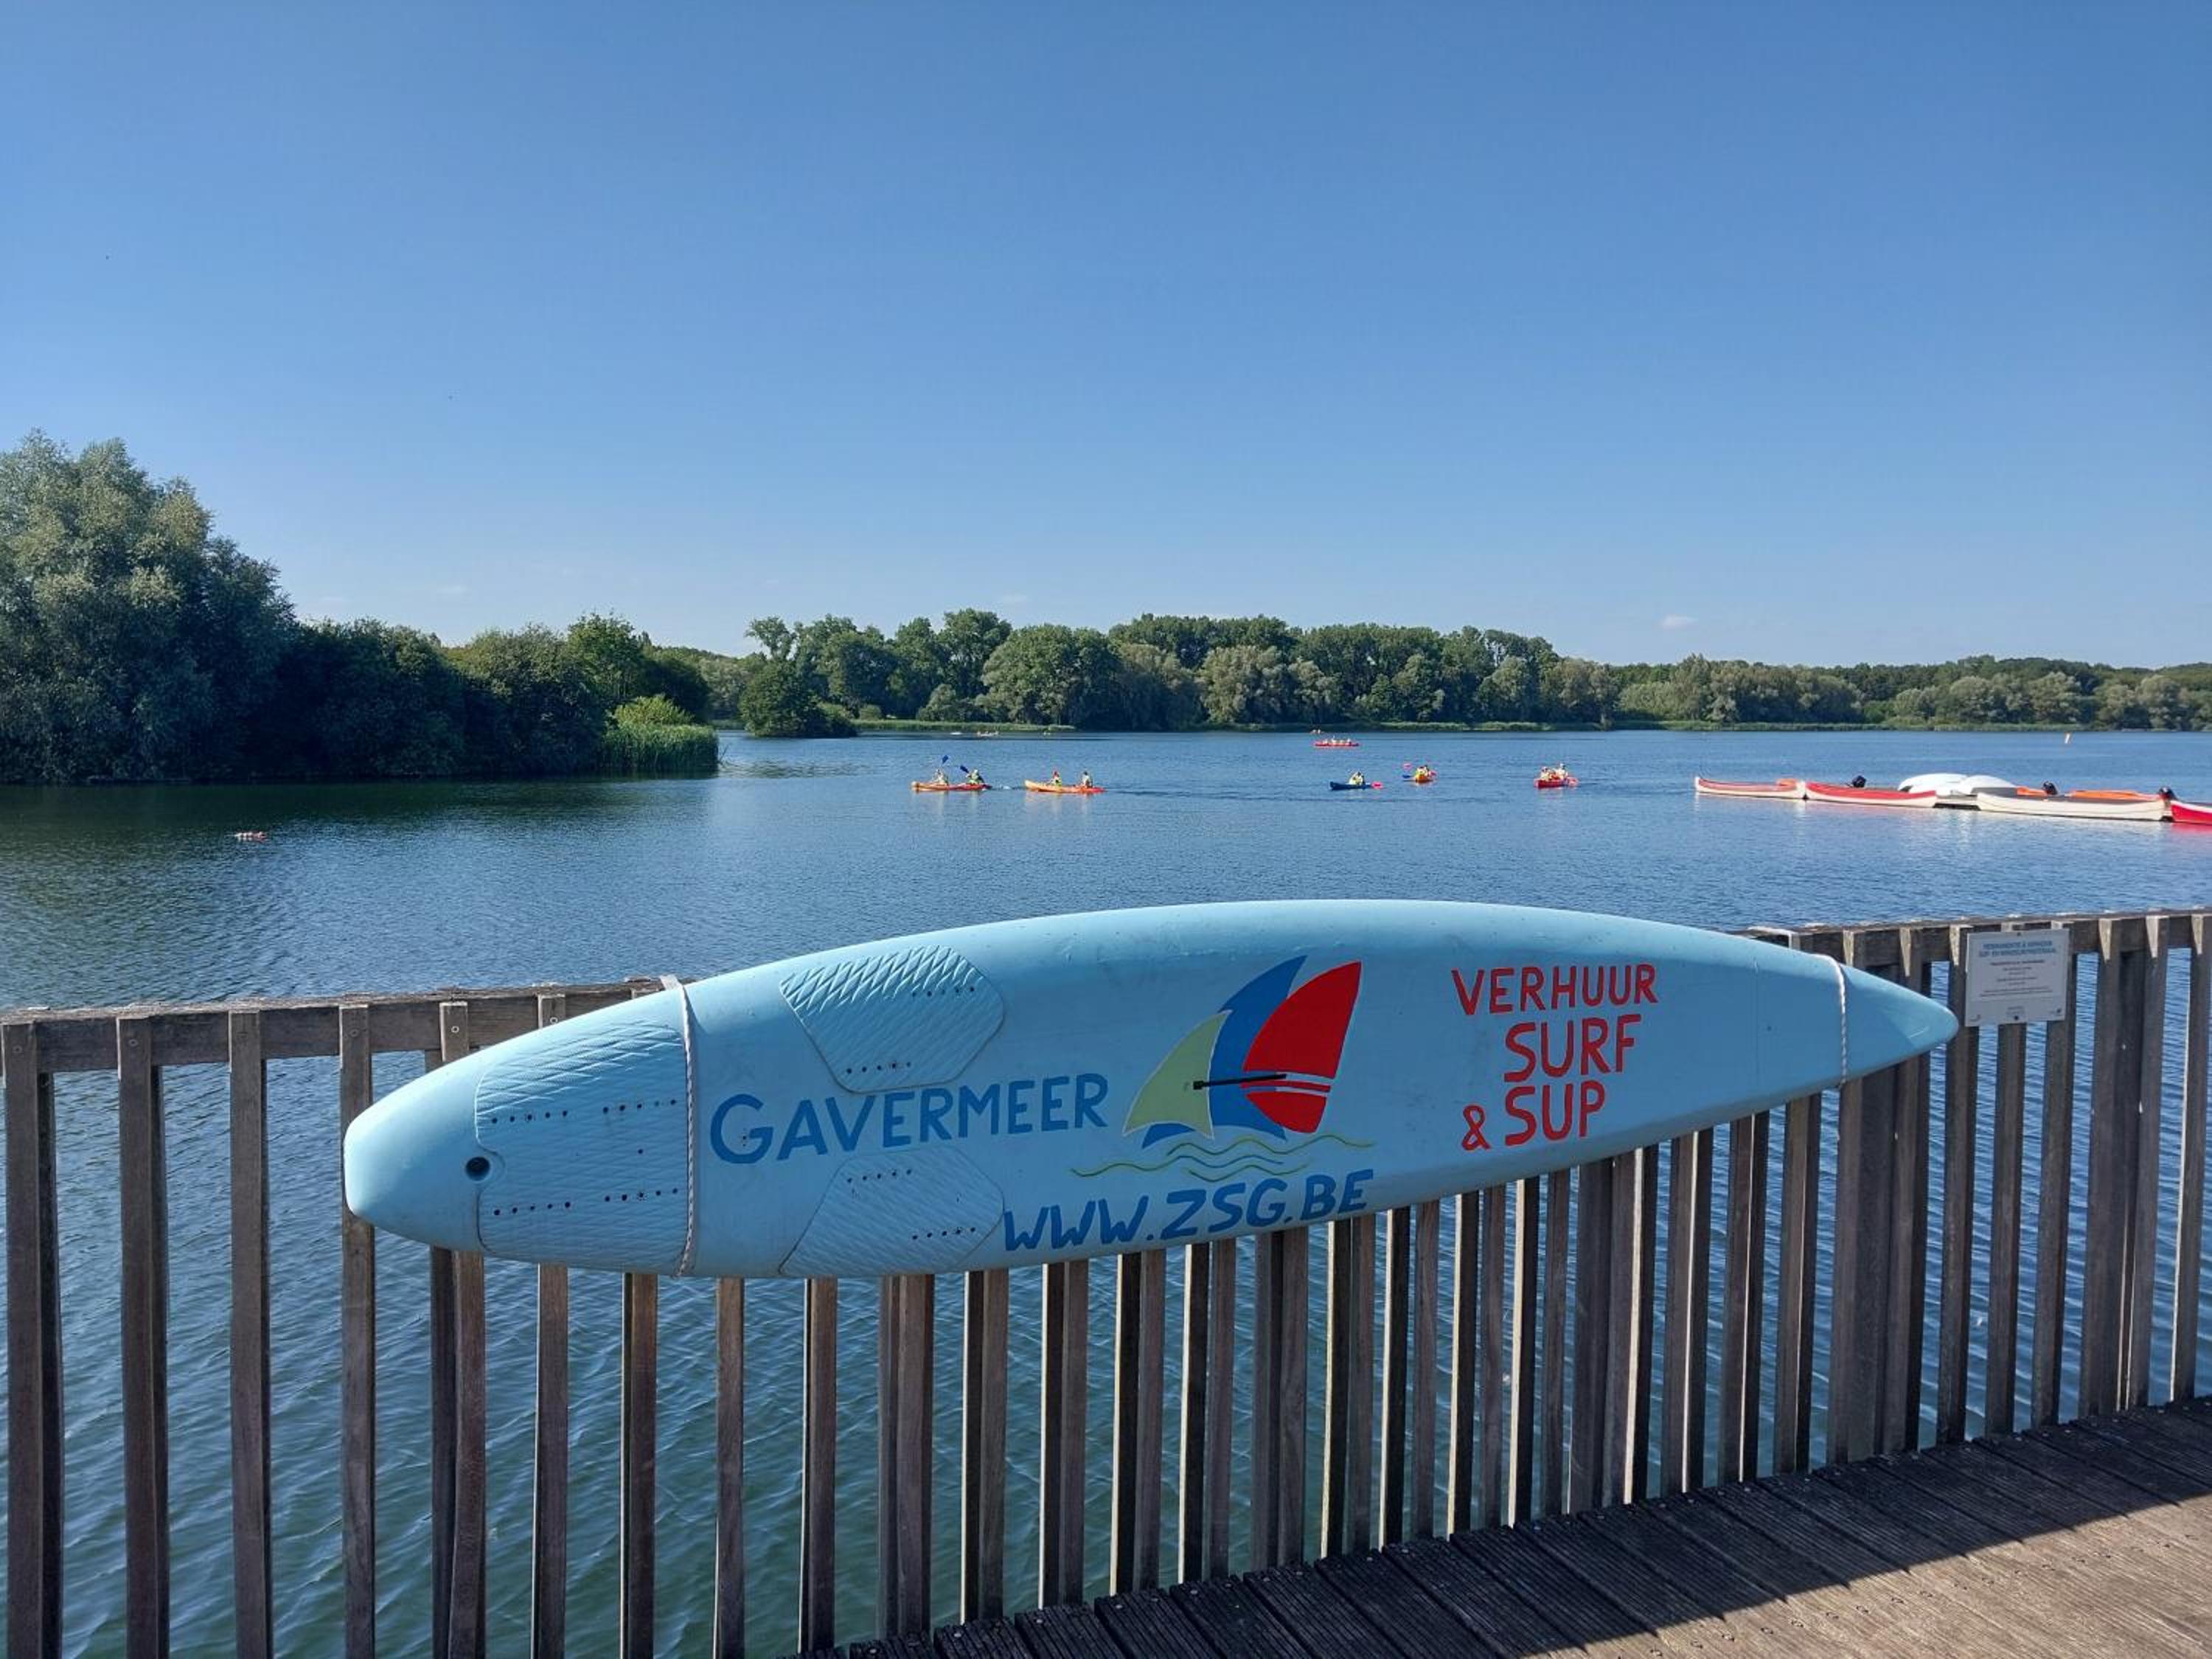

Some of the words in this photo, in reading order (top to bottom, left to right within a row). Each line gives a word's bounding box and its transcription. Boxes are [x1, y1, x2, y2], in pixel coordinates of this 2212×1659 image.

[1451, 964, 1658, 1015] VERHUUR
[1504, 1014, 1641, 1082] SURF
[710, 1073, 1108, 1164] GAVERMEER
[1461, 1105, 1491, 1151] &
[1505, 1080, 1606, 1146] SUP
[1004, 1169, 1374, 1251] WWW.ZSG.BE
